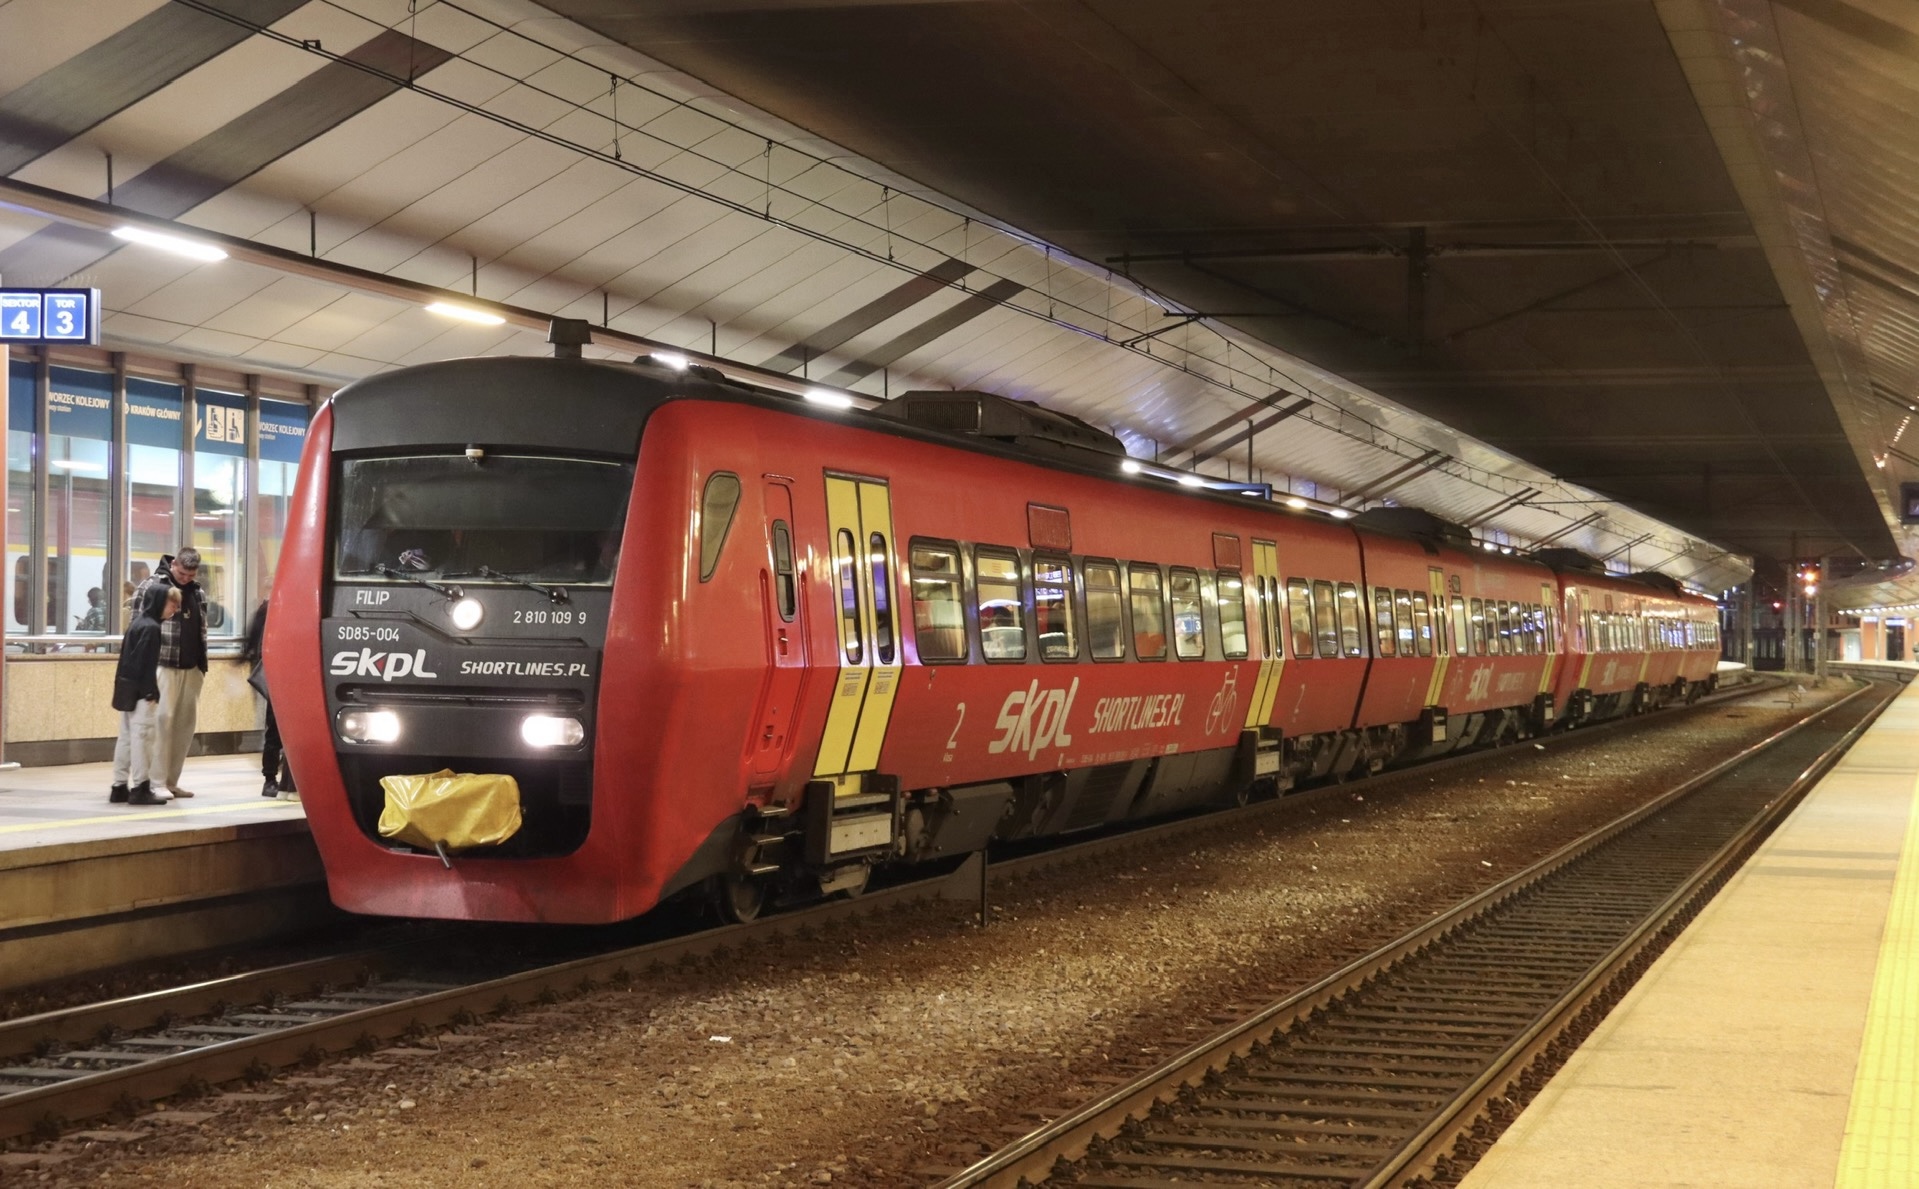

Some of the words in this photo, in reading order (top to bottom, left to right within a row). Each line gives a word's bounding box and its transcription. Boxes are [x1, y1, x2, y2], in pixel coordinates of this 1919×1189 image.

[55, 299, 76, 308] TOR
[11, 310, 31, 334] 4
[56, 310, 74, 335] 3
[75, 396, 110, 409] KOLEJOWY
[130, 403, 156, 417] KRAKÓW
[156, 407, 181, 420] GŁÓWNY
[279, 425, 306, 436] KOLEJOWY
[355, 590, 390, 606] FILIP
[513, 610, 522, 624] 2
[525, 610, 547, 624] 810
[551, 611, 572, 624] 109
[578, 611, 587, 625] 9
[337, 626, 400, 642] SD85-004
[459, 660, 590, 677] SHORTLINES.PL
[1088, 693, 1186, 734] SHORTLINES.PL
[946, 702, 966, 749] 2
